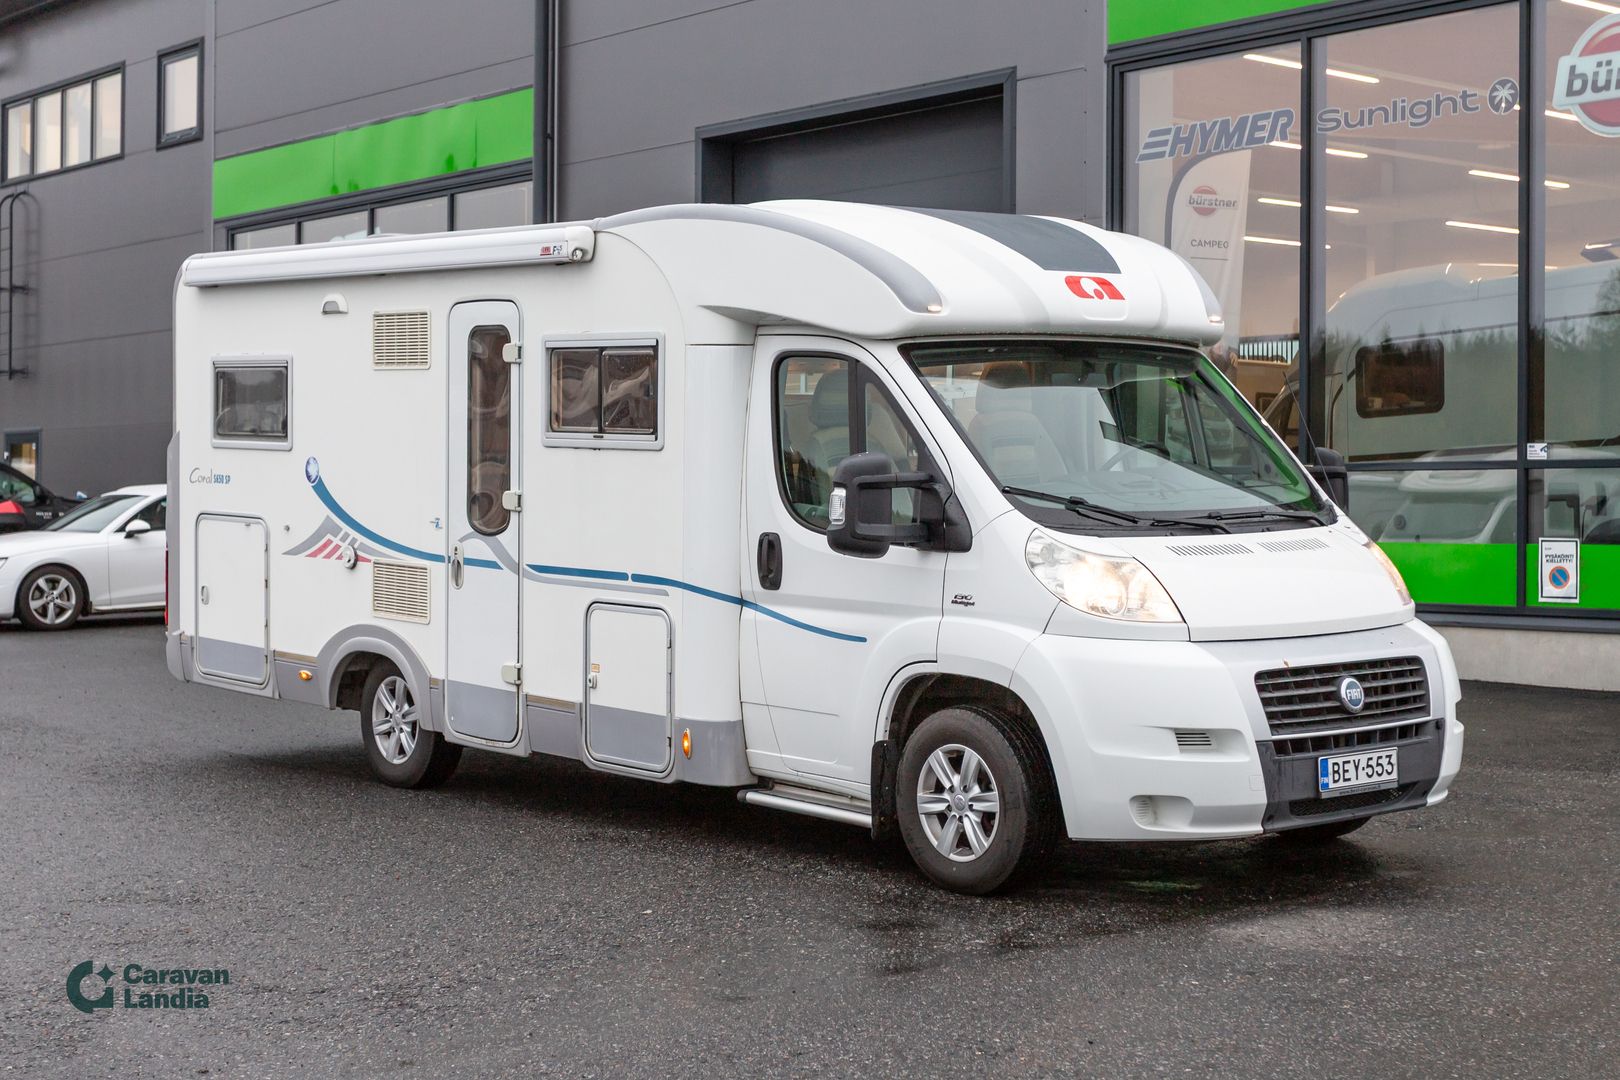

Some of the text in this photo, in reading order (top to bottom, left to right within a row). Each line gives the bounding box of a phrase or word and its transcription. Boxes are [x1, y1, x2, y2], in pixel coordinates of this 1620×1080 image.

[1317, 89, 1480, 132] Sunlight
[1166, 108, 1295, 158] HYMER
[1188, 194, 1238, 208] bürstner
[1190, 239, 1230, 249] CAMPEO
[1346, 688, 1362, 701] FIAT
[1332, 754, 1394, 784] BEY-553
